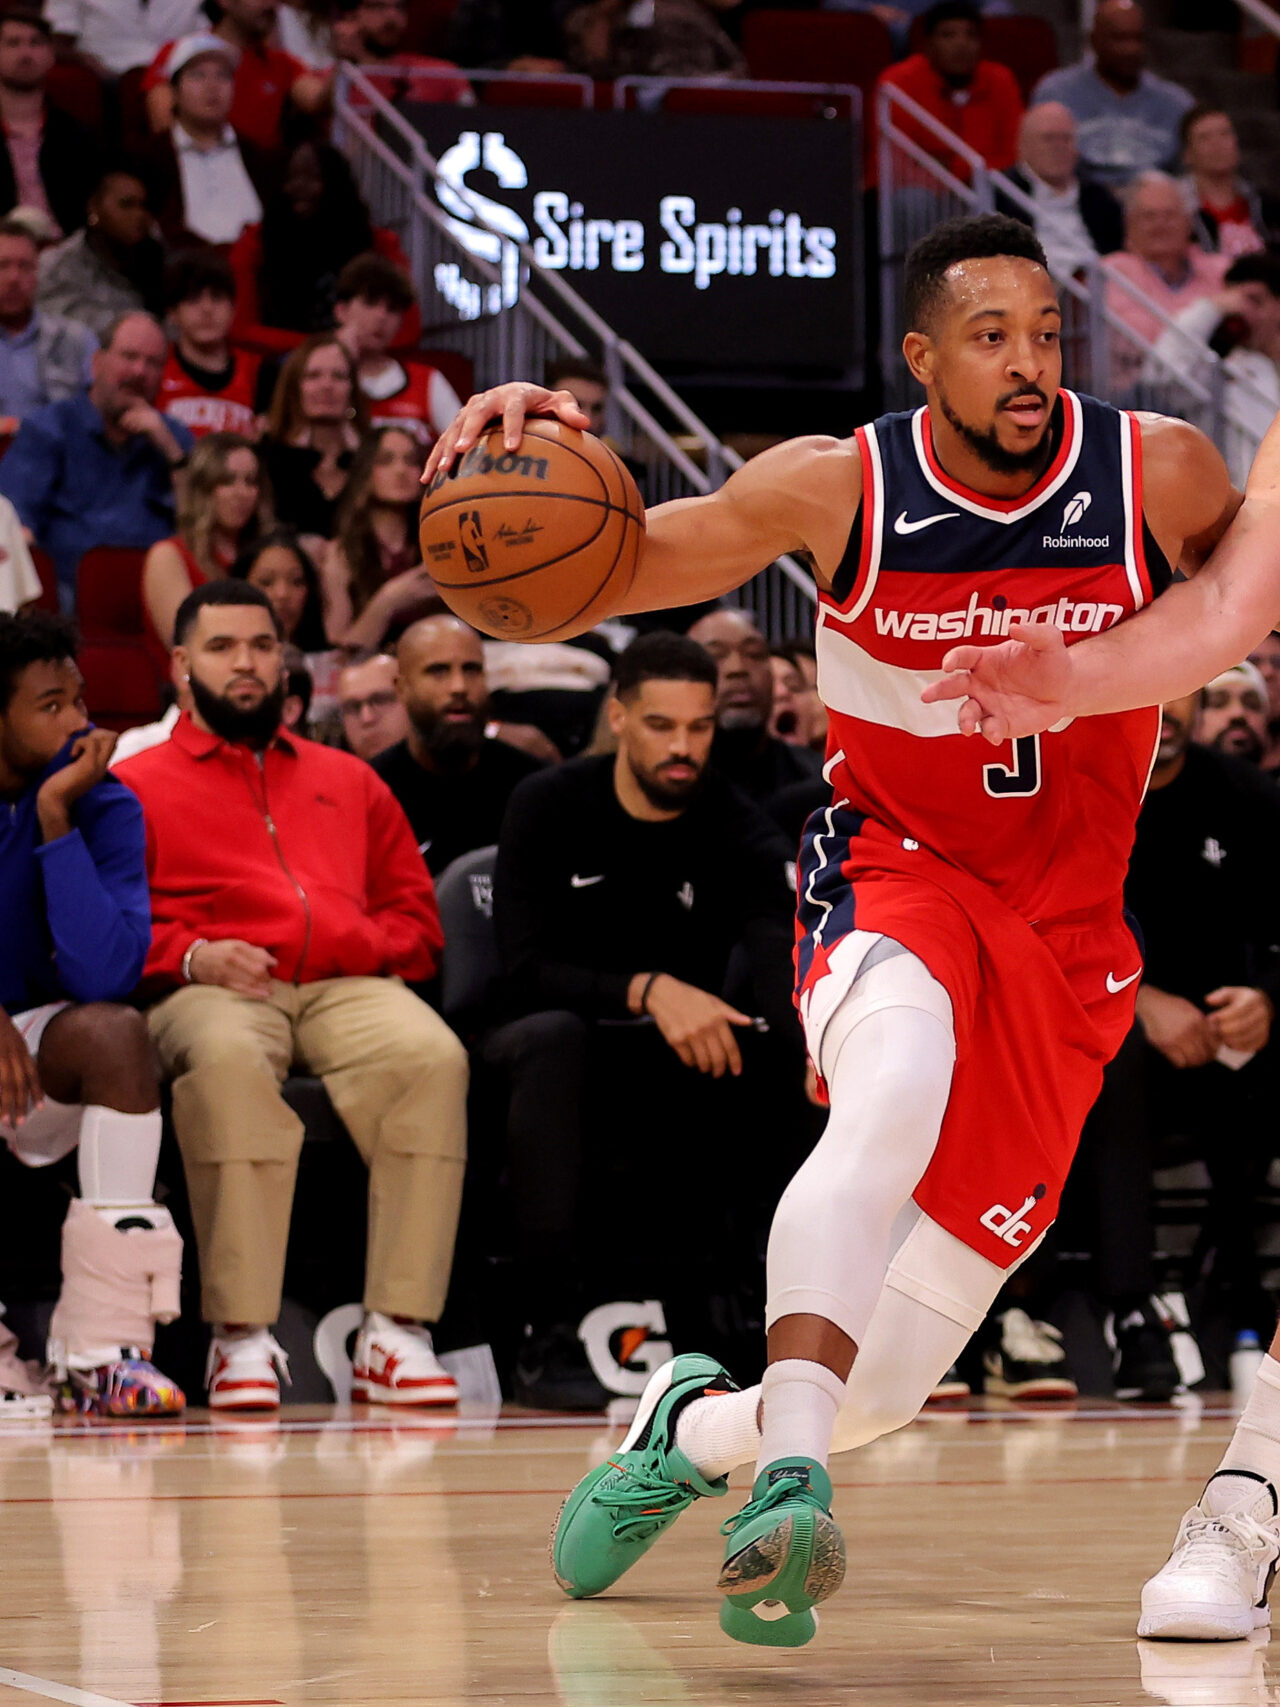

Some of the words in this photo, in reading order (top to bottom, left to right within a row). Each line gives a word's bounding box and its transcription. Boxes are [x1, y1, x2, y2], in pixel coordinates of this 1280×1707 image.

[533, 191, 644, 272] Sire
[659, 195, 837, 290] Spirits
[1042, 535, 1110, 548] Robinhood
